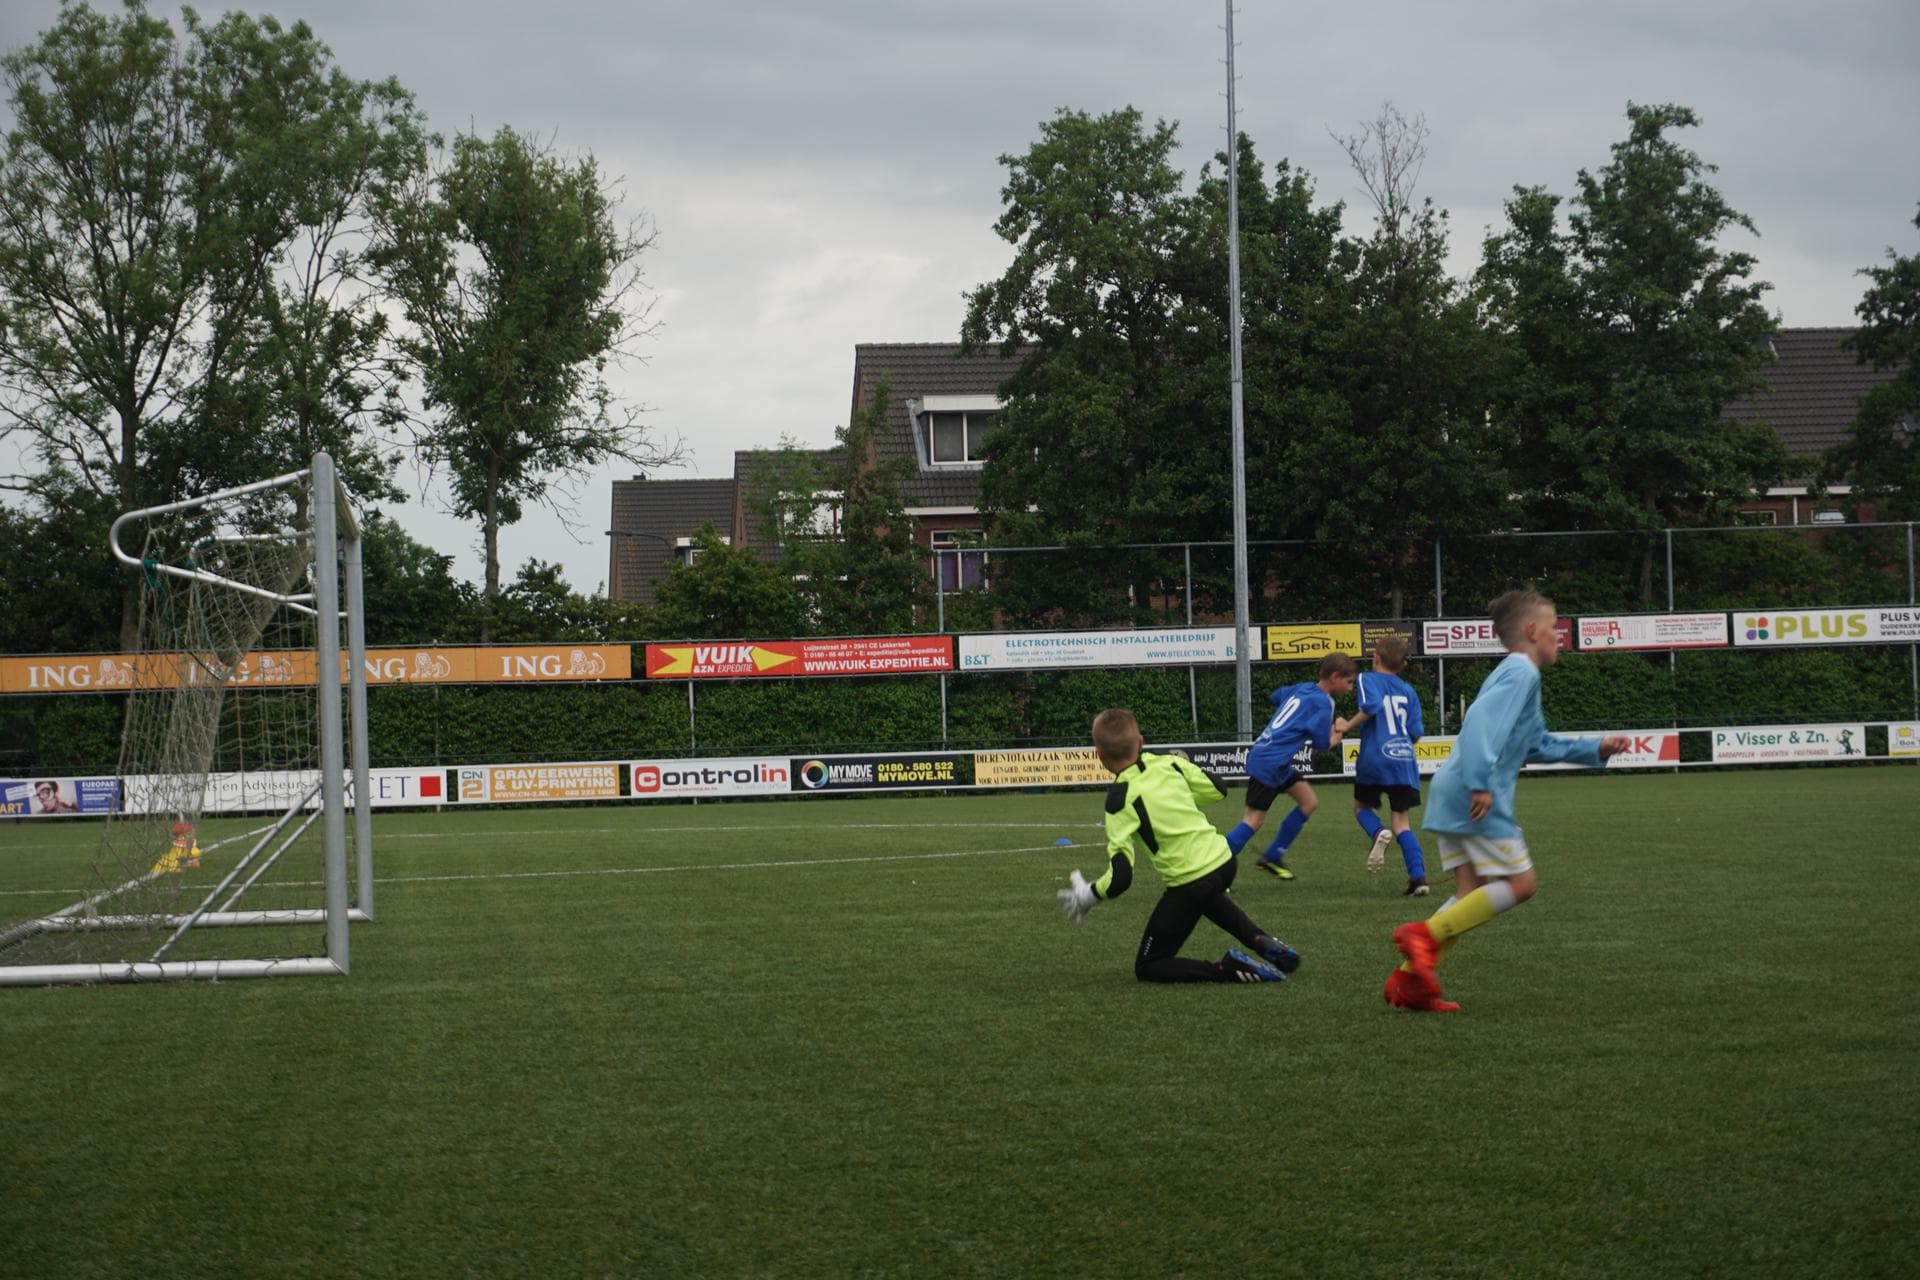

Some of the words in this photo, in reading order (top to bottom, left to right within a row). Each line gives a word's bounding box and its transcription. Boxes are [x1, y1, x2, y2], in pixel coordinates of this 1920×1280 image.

[1880, 612, 1910, 622] PLUS
[1775, 614, 1868, 640] PLUS
[1006, 637, 1106, 648] ELECTROTECHNISCH
[1111, 633, 1216, 645] INSTALLATIEBEDRIJF
[1335, 639, 1358, 650] b.v.
[695, 645, 755, 665] VUIK
[965, 654, 990, 666] B&T
[1147, 649, 1216, 659] WWW.BTELECTRO.NL
[502, 655, 562, 677] ING
[717, 663, 753, 673] EXPEDITIE
[804, 656, 949, 672] WWW.VUIK-EXPEDITIE.NL
[28, 664, 91, 688] ING
[1383, 695, 1408, 736] 15
[1716, 732, 1731, 746] P.
[1736, 731, 1783, 746] Visser
[1788, 730, 1801, 744] &
[1806, 730, 1830, 743] Zn.
[829, 766, 844, 778] MY
[845, 764, 873, 778] MOVE
[877, 763, 903, 772] 0180
[912, 762, 932, 771] 580
[934, 761, 954, 771] 522
[462, 771, 483, 780] CN
[494, 768, 615, 780] GRAVEERWERK
[877, 770, 955, 783] MYMOVE.NL
[222, 784, 238, 792] en
[243, 779, 307, 792] Adviseurs
[494, 781, 506, 790] &
[511, 777, 616, 790] UV-PRINTING
